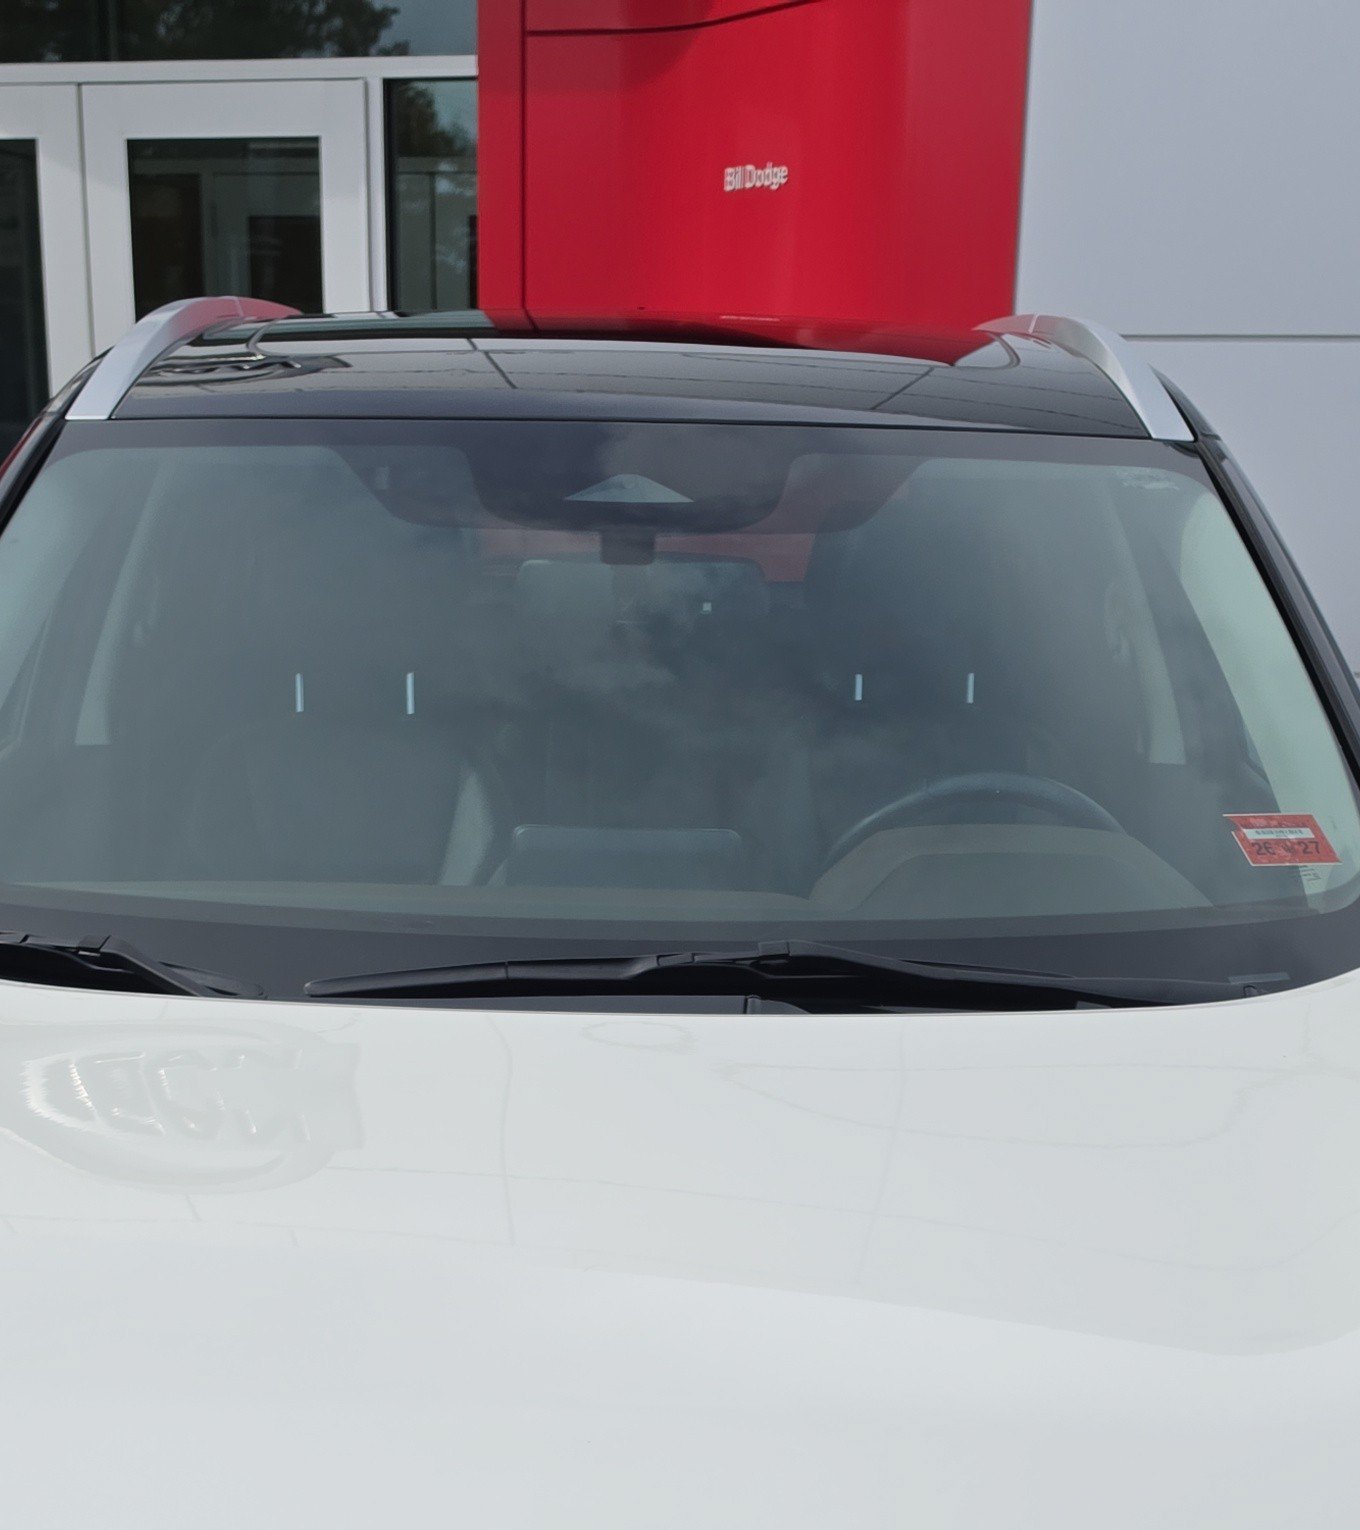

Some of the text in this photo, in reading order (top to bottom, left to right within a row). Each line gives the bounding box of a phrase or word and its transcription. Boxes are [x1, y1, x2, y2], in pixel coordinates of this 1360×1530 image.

[725, 162, 788, 191] Bill Dodge
[1298, 841, 1321, 855] 27
